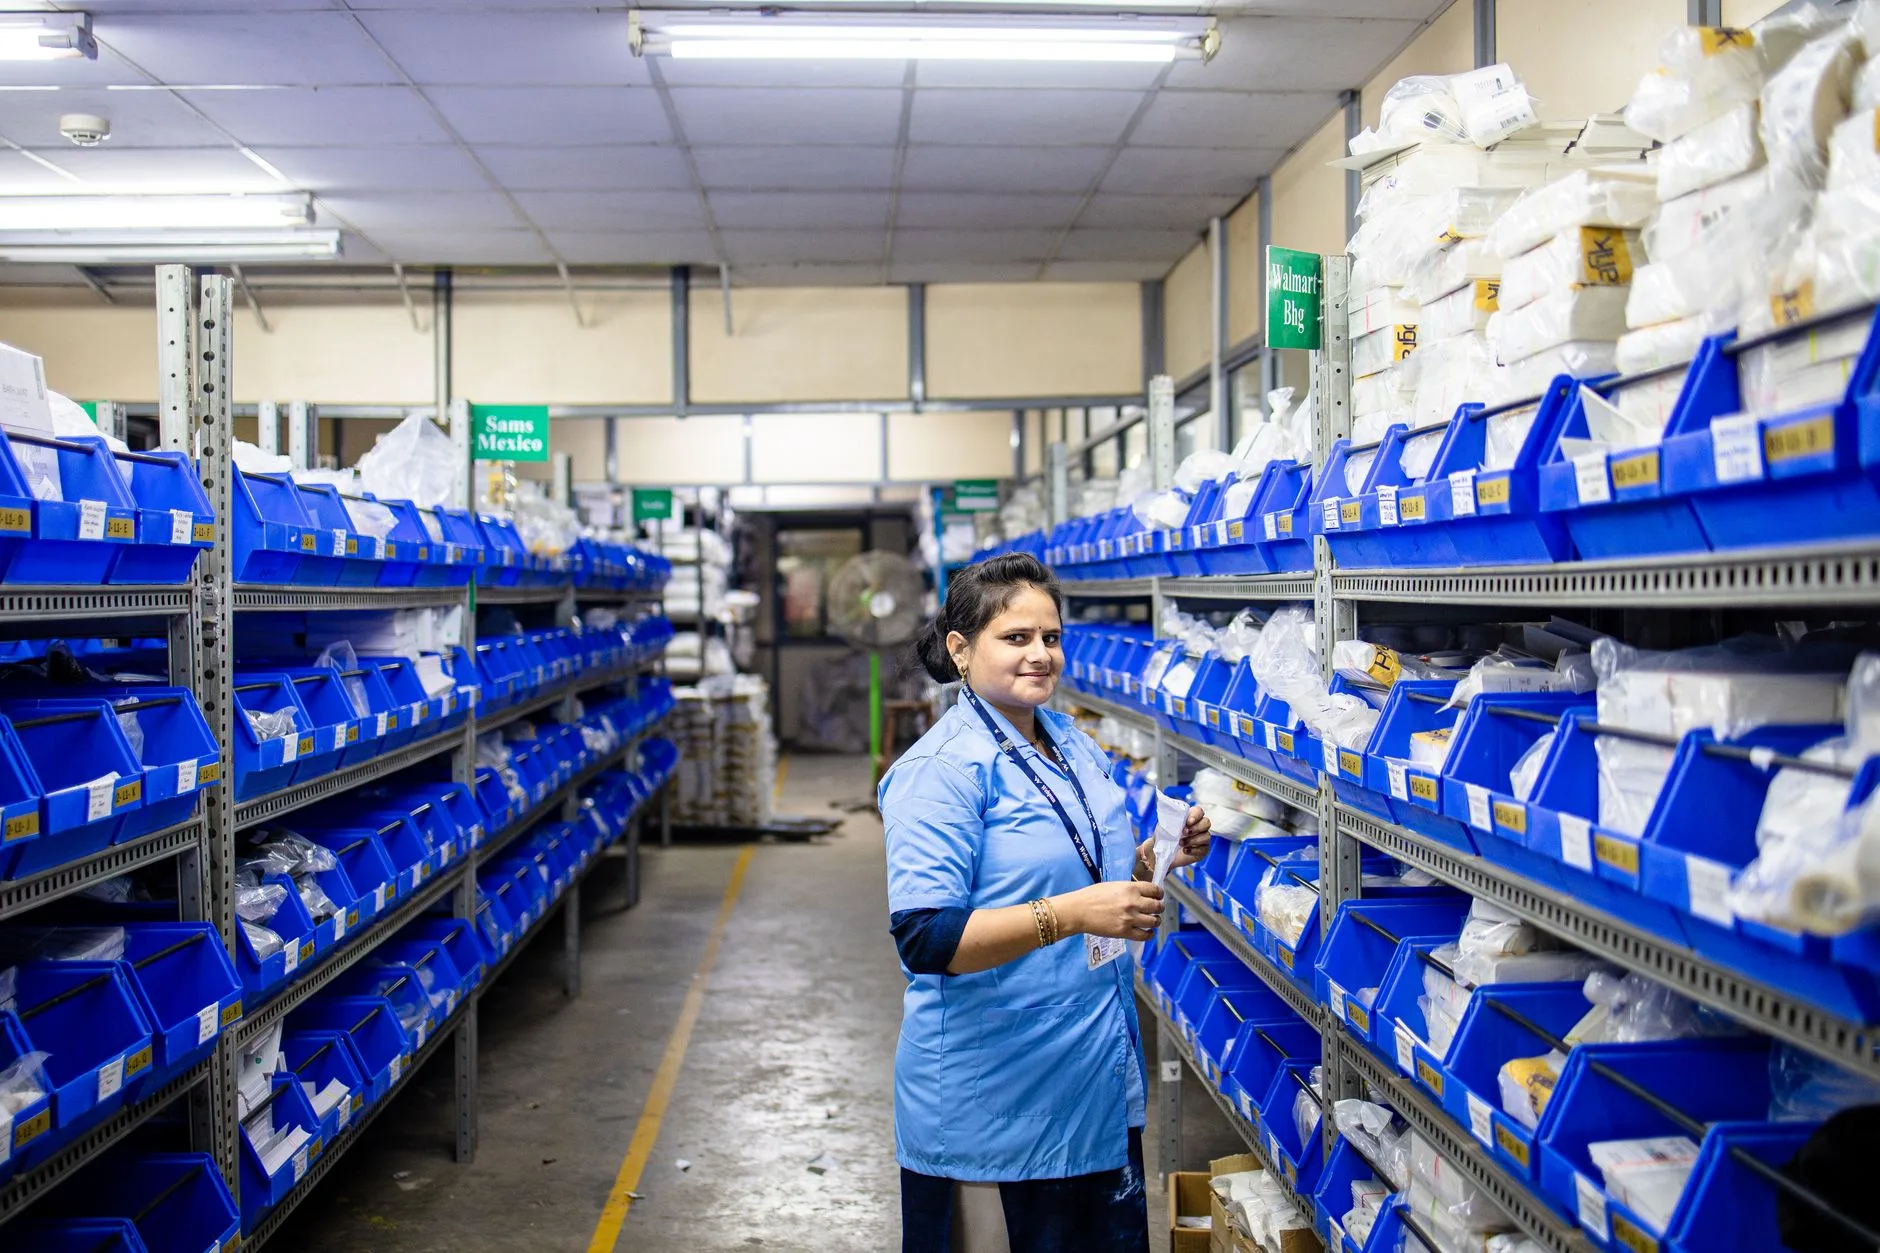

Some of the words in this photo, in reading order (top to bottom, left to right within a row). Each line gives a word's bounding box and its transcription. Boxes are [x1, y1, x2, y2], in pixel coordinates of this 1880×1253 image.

[1272, 264, 1317, 295] Walmart
[1284, 299, 1304, 333] Bhg
[485, 415, 534, 433] Sams
[478, 433, 543, 451] Mexico
[0, 512, 24, 525] -L1-D
